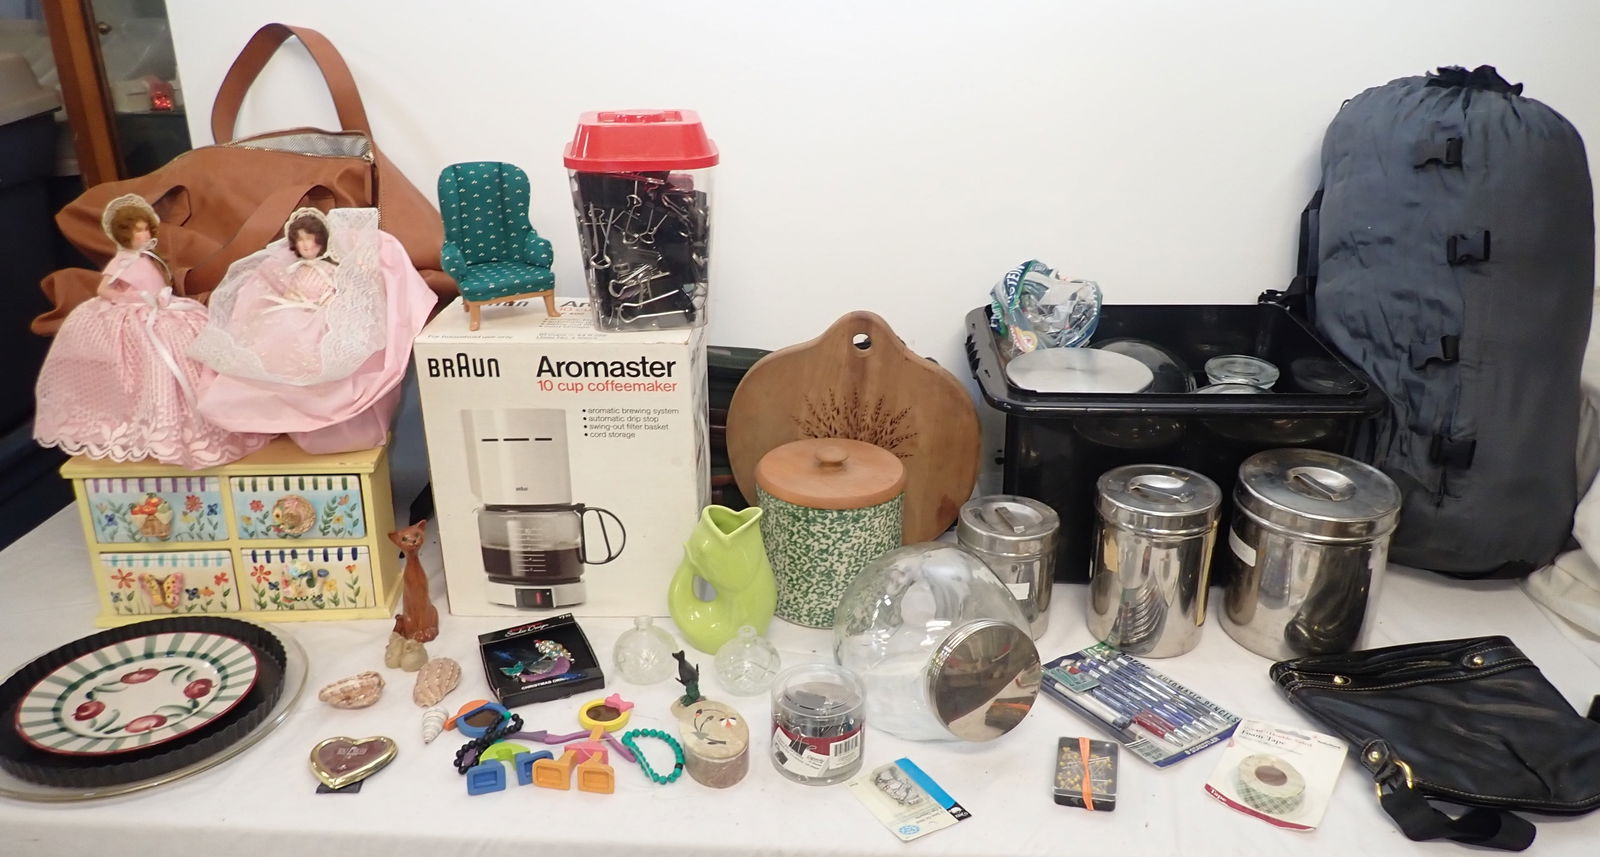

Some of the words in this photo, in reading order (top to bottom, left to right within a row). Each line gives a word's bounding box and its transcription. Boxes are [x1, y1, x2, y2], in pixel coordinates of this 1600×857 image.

[536, 355, 677, 378] Aromaster
[537, 380, 554, 392] 10
[557, 381, 584, 393] cup
[587, 380, 677, 392] coffeemaker
